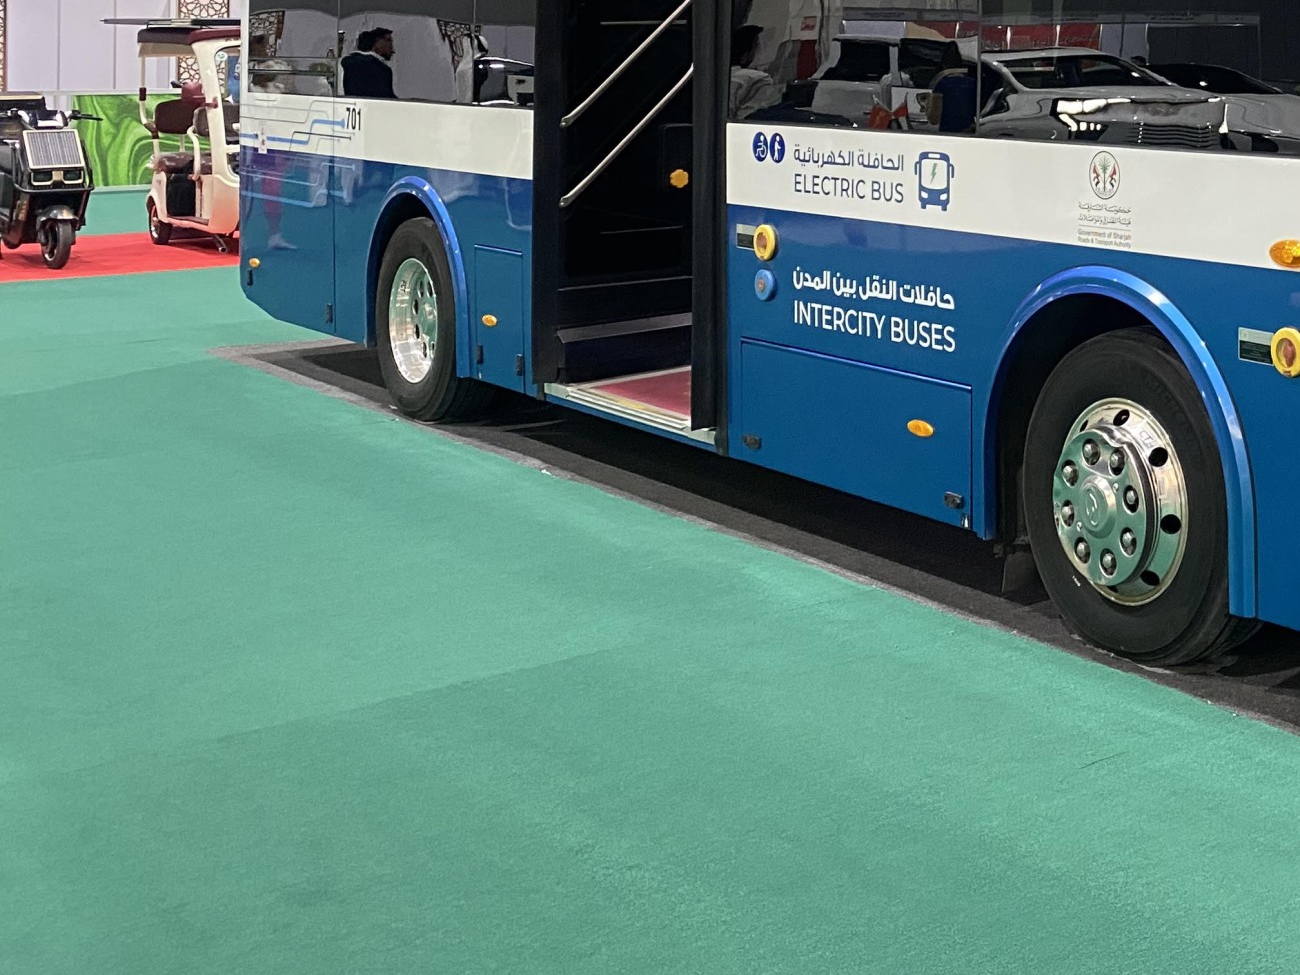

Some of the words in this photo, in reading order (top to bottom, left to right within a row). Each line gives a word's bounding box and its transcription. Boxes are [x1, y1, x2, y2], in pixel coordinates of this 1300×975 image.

[346, 107, 361, 131] 701
[794, 143, 854, 168] الكهربائية
[857, 149, 905, 172] الحافلة
[794, 173, 866, 200] ELECTRIC
[871, 180, 905, 204] BUS
[1078, 228, 1106, 237] Government
[1113, 232, 1131, 241] Sharjah
[793, 266, 831, 290] المدن
[833, 273, 857, 298] بين
[858, 275, 897, 300] النقل
[900, 284, 955, 310] حافلات
[794, 300, 885, 339] INTERCITY
[891, 316, 956, 353] BUSES
